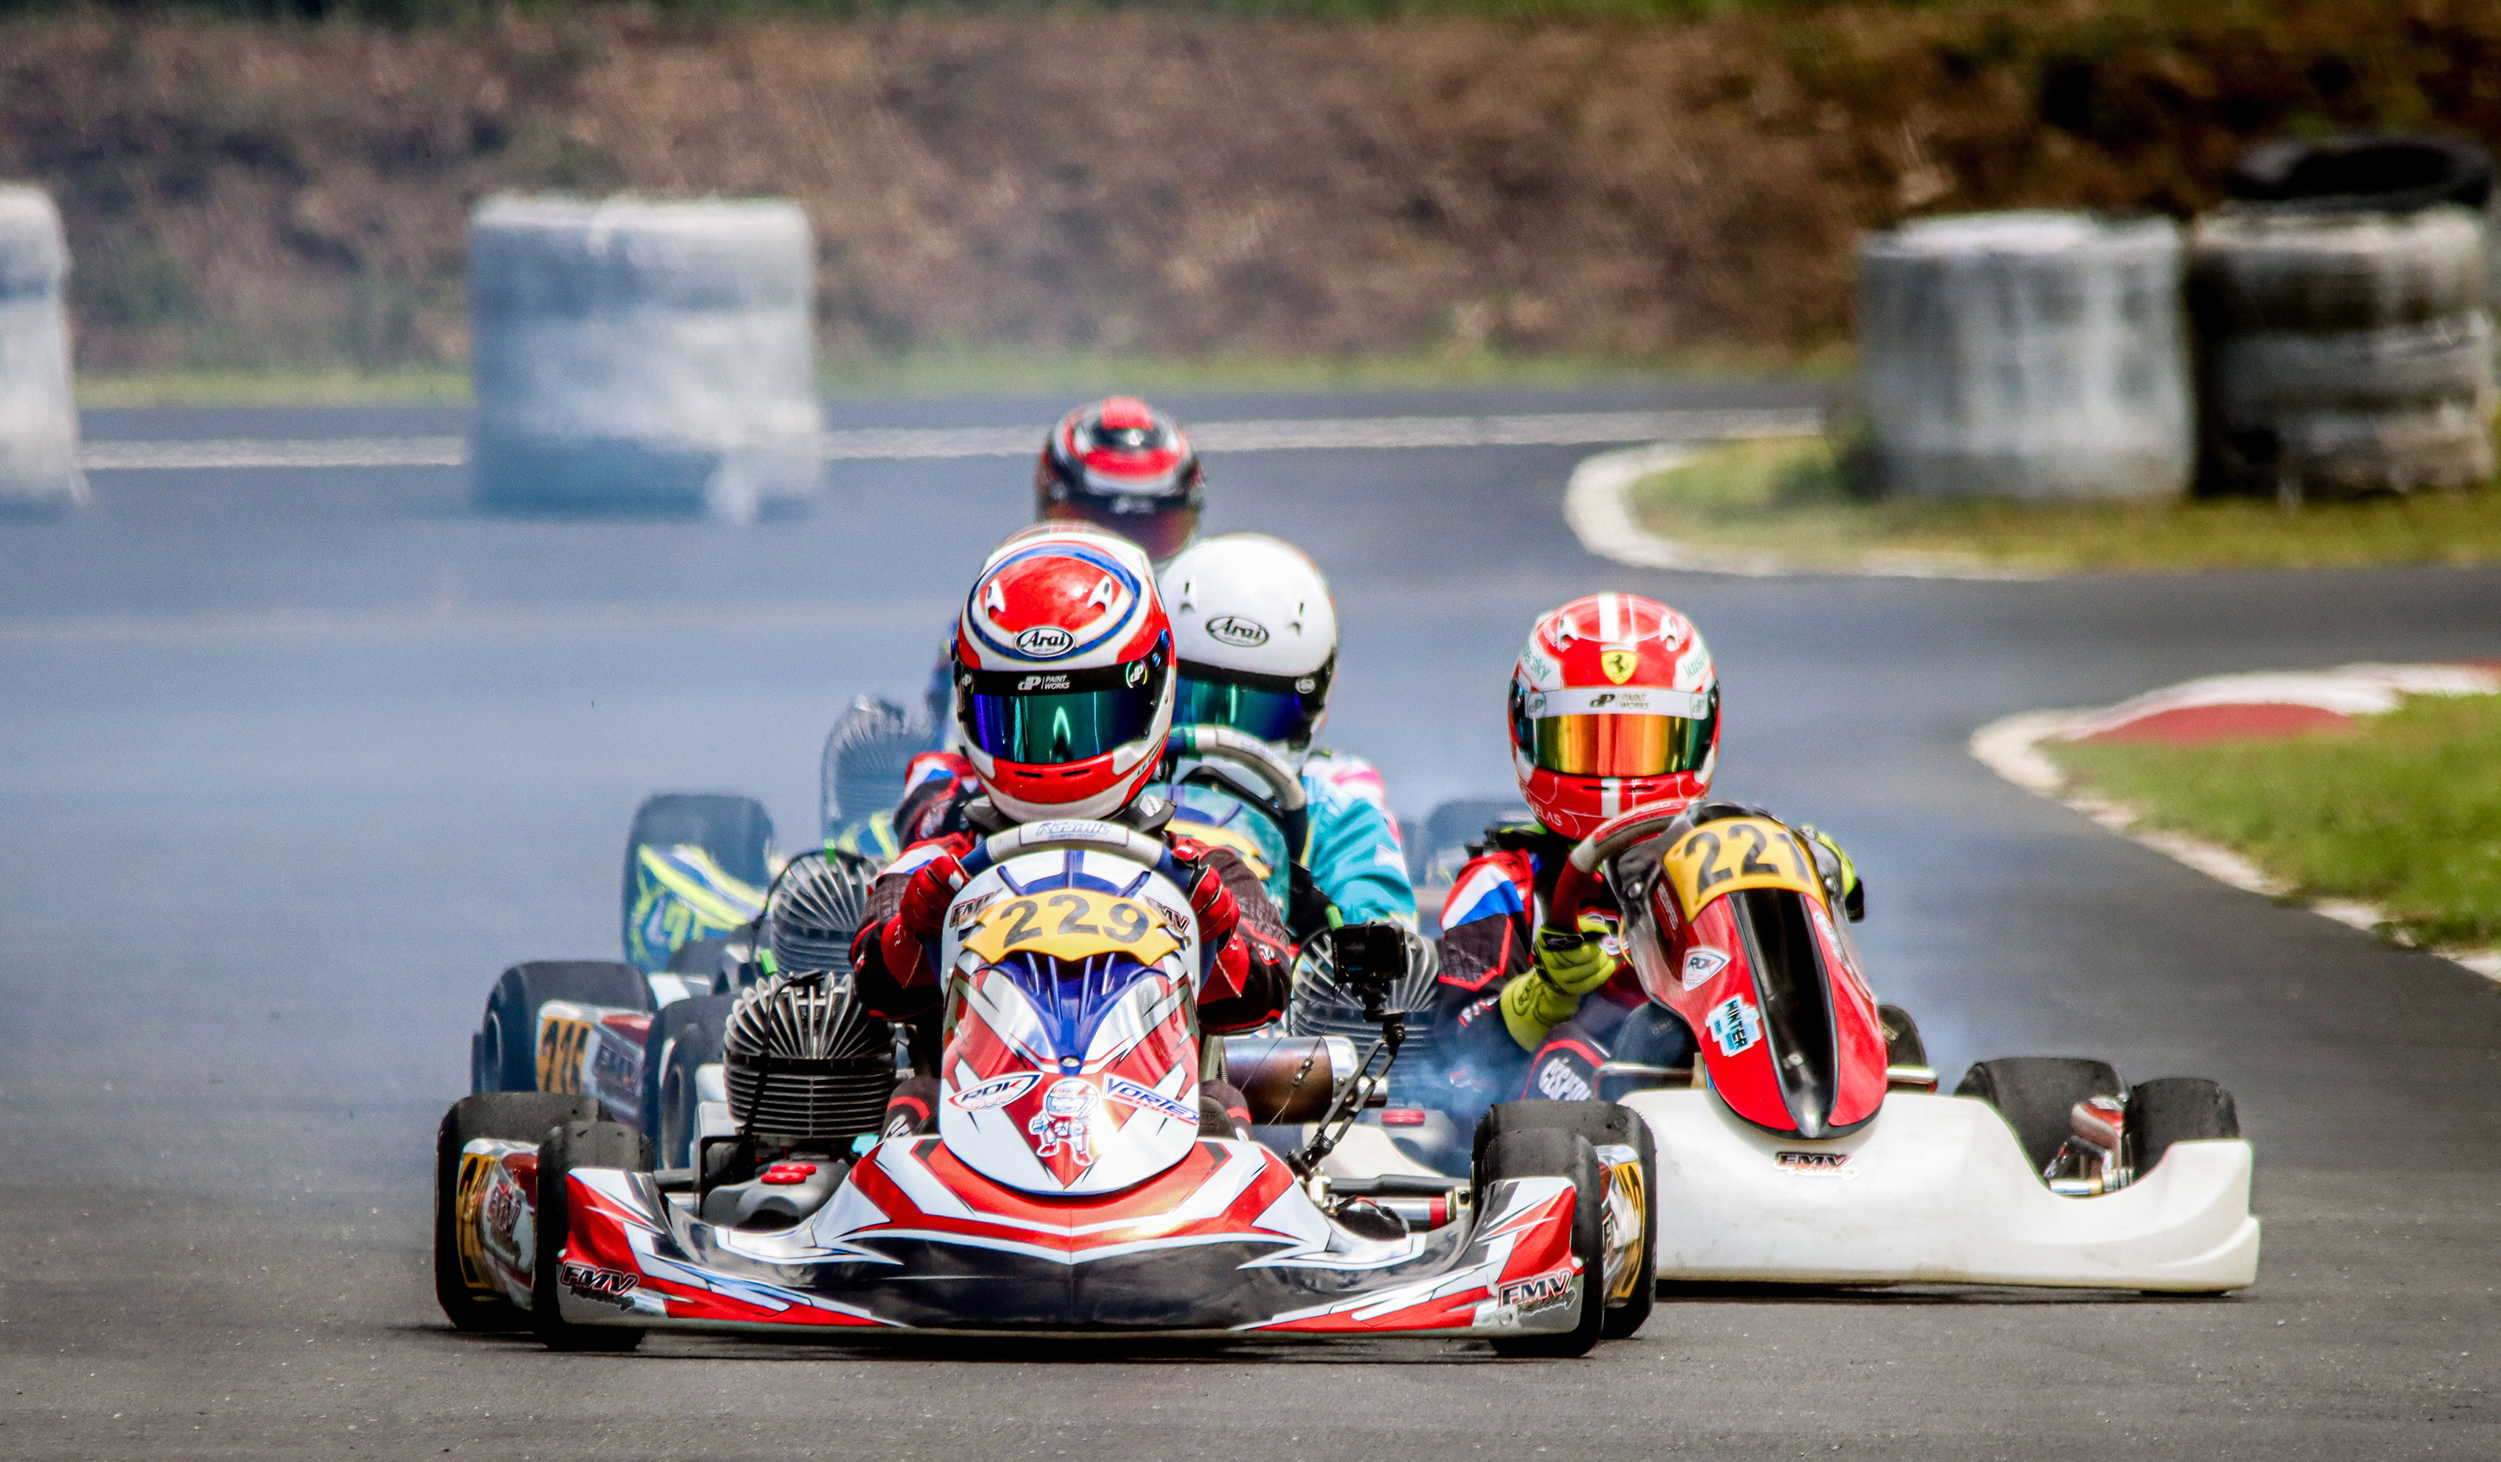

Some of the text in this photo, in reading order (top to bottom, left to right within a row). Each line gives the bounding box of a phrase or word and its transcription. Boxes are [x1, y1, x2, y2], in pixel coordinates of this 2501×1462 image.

[1020, 629, 1067, 648] Arai
[1223, 617, 1264, 640] Arai
[1044, 681, 1070, 690] WORKS
[1045, 675, 1067, 683] PAINT
[1684, 823, 1813, 894] 221
[999, 894, 1150, 949] 229
[1725, 999, 1749, 1051] WINTER
[960, 1079, 1024, 1103] ROK
[1106, 1078, 1200, 1122] VORTEX
[1776, 1152, 1851, 1169] FMV
[561, 1264, 638, 1296] FMV
[1500, 1271, 1571, 1306] FMV
